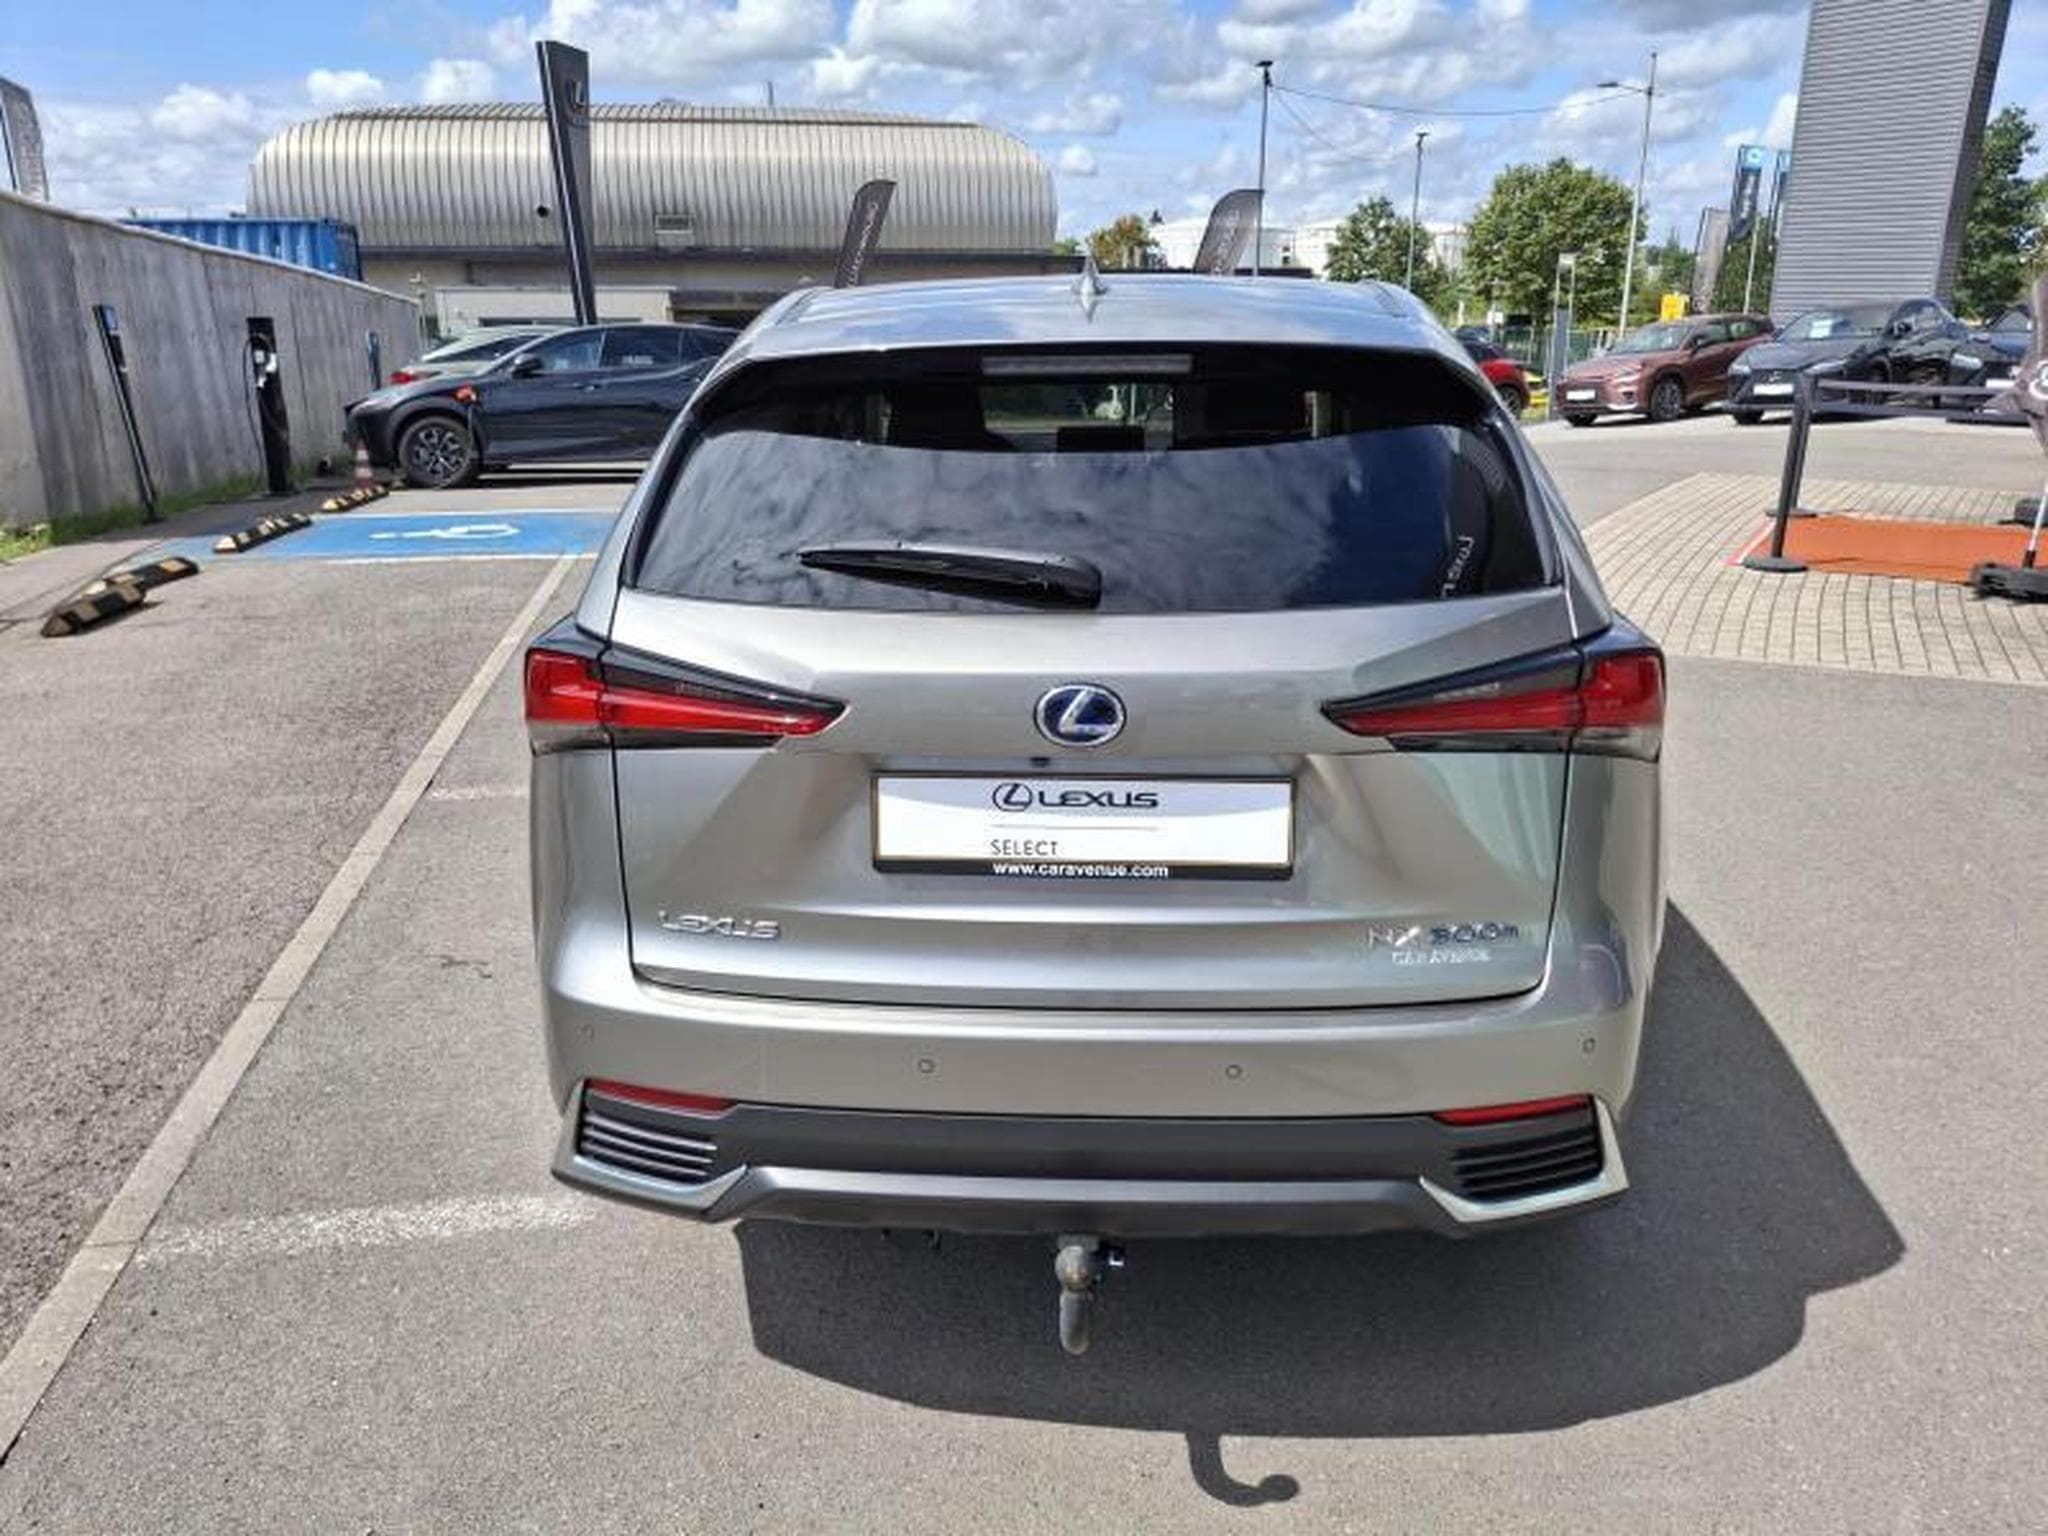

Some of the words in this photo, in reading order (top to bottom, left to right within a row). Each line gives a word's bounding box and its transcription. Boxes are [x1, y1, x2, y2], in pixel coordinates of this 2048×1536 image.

[1039, 790, 1159, 808] LEXUS
[990, 839, 1059, 856] SELECT
[992, 863, 1169, 878] www.caravenue.com
[657, 909, 781, 939] LEXUS
